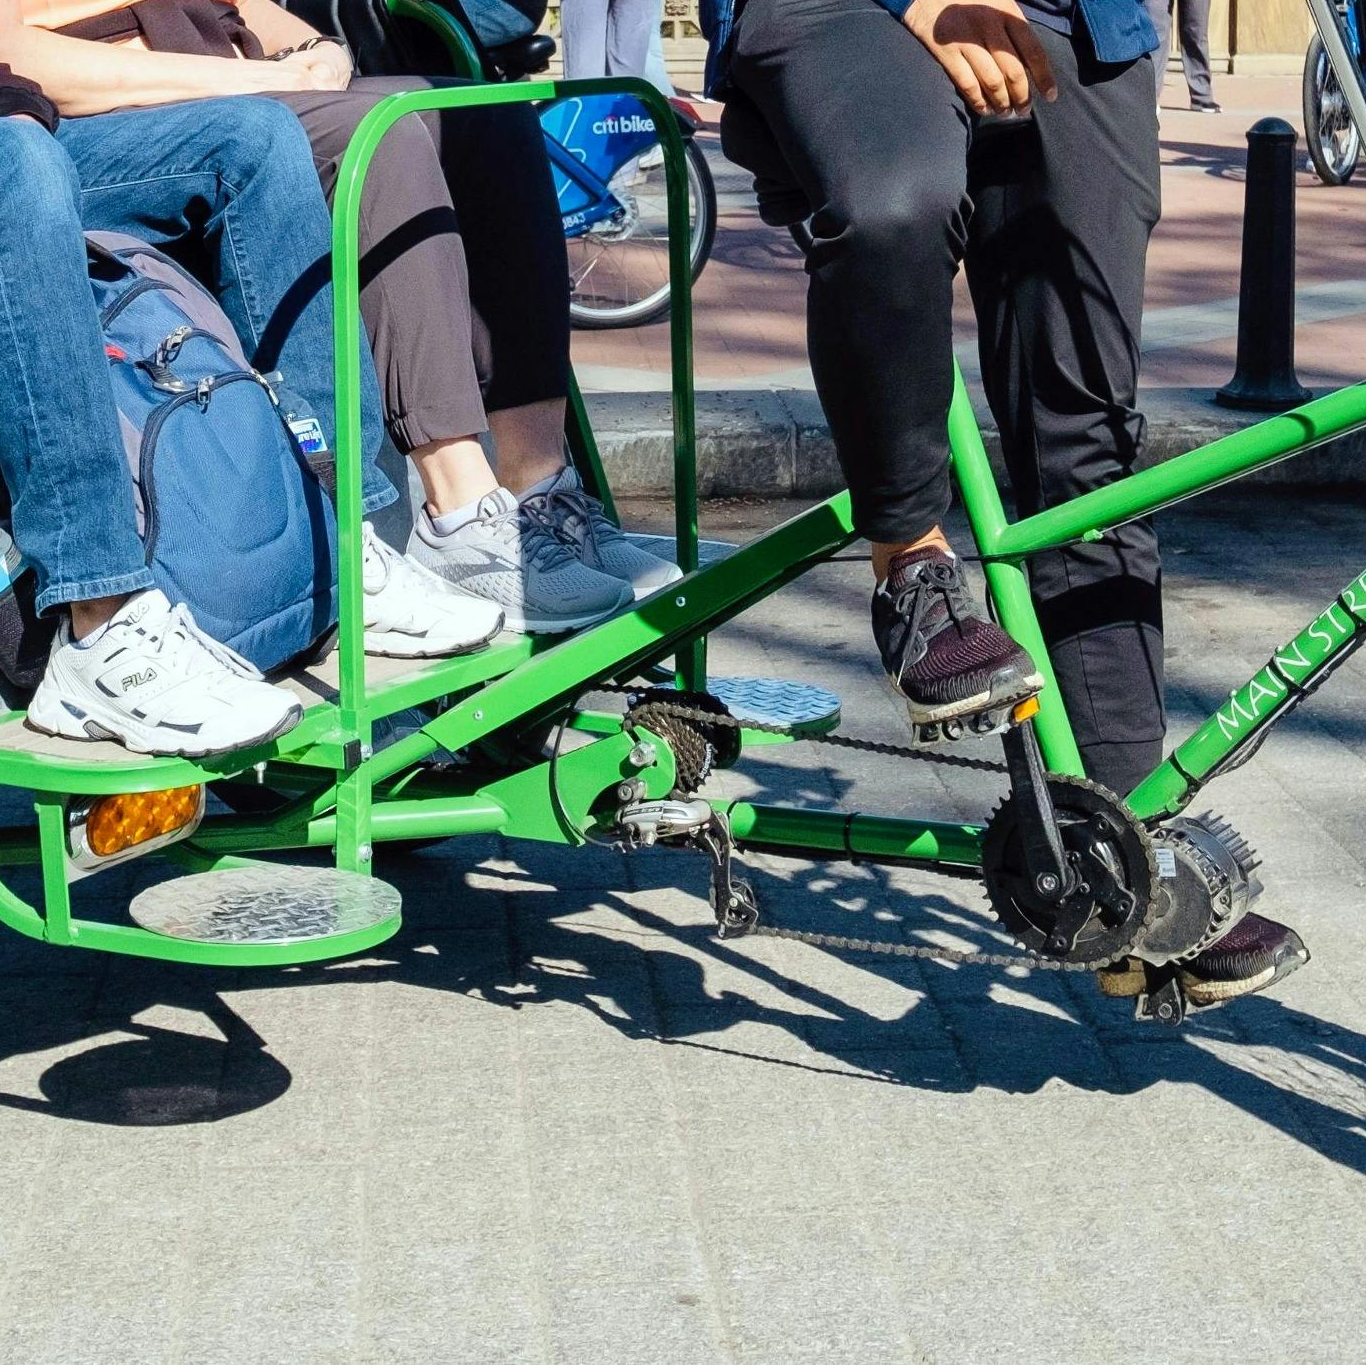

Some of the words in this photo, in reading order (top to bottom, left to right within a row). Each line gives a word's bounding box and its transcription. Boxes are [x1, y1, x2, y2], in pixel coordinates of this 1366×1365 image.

[592, 114, 618, 135] citi
[620, 116, 655, 134] bike
[121, 667, 158, 692] FILA
[1216, 640, 1312, 741] MAIN
